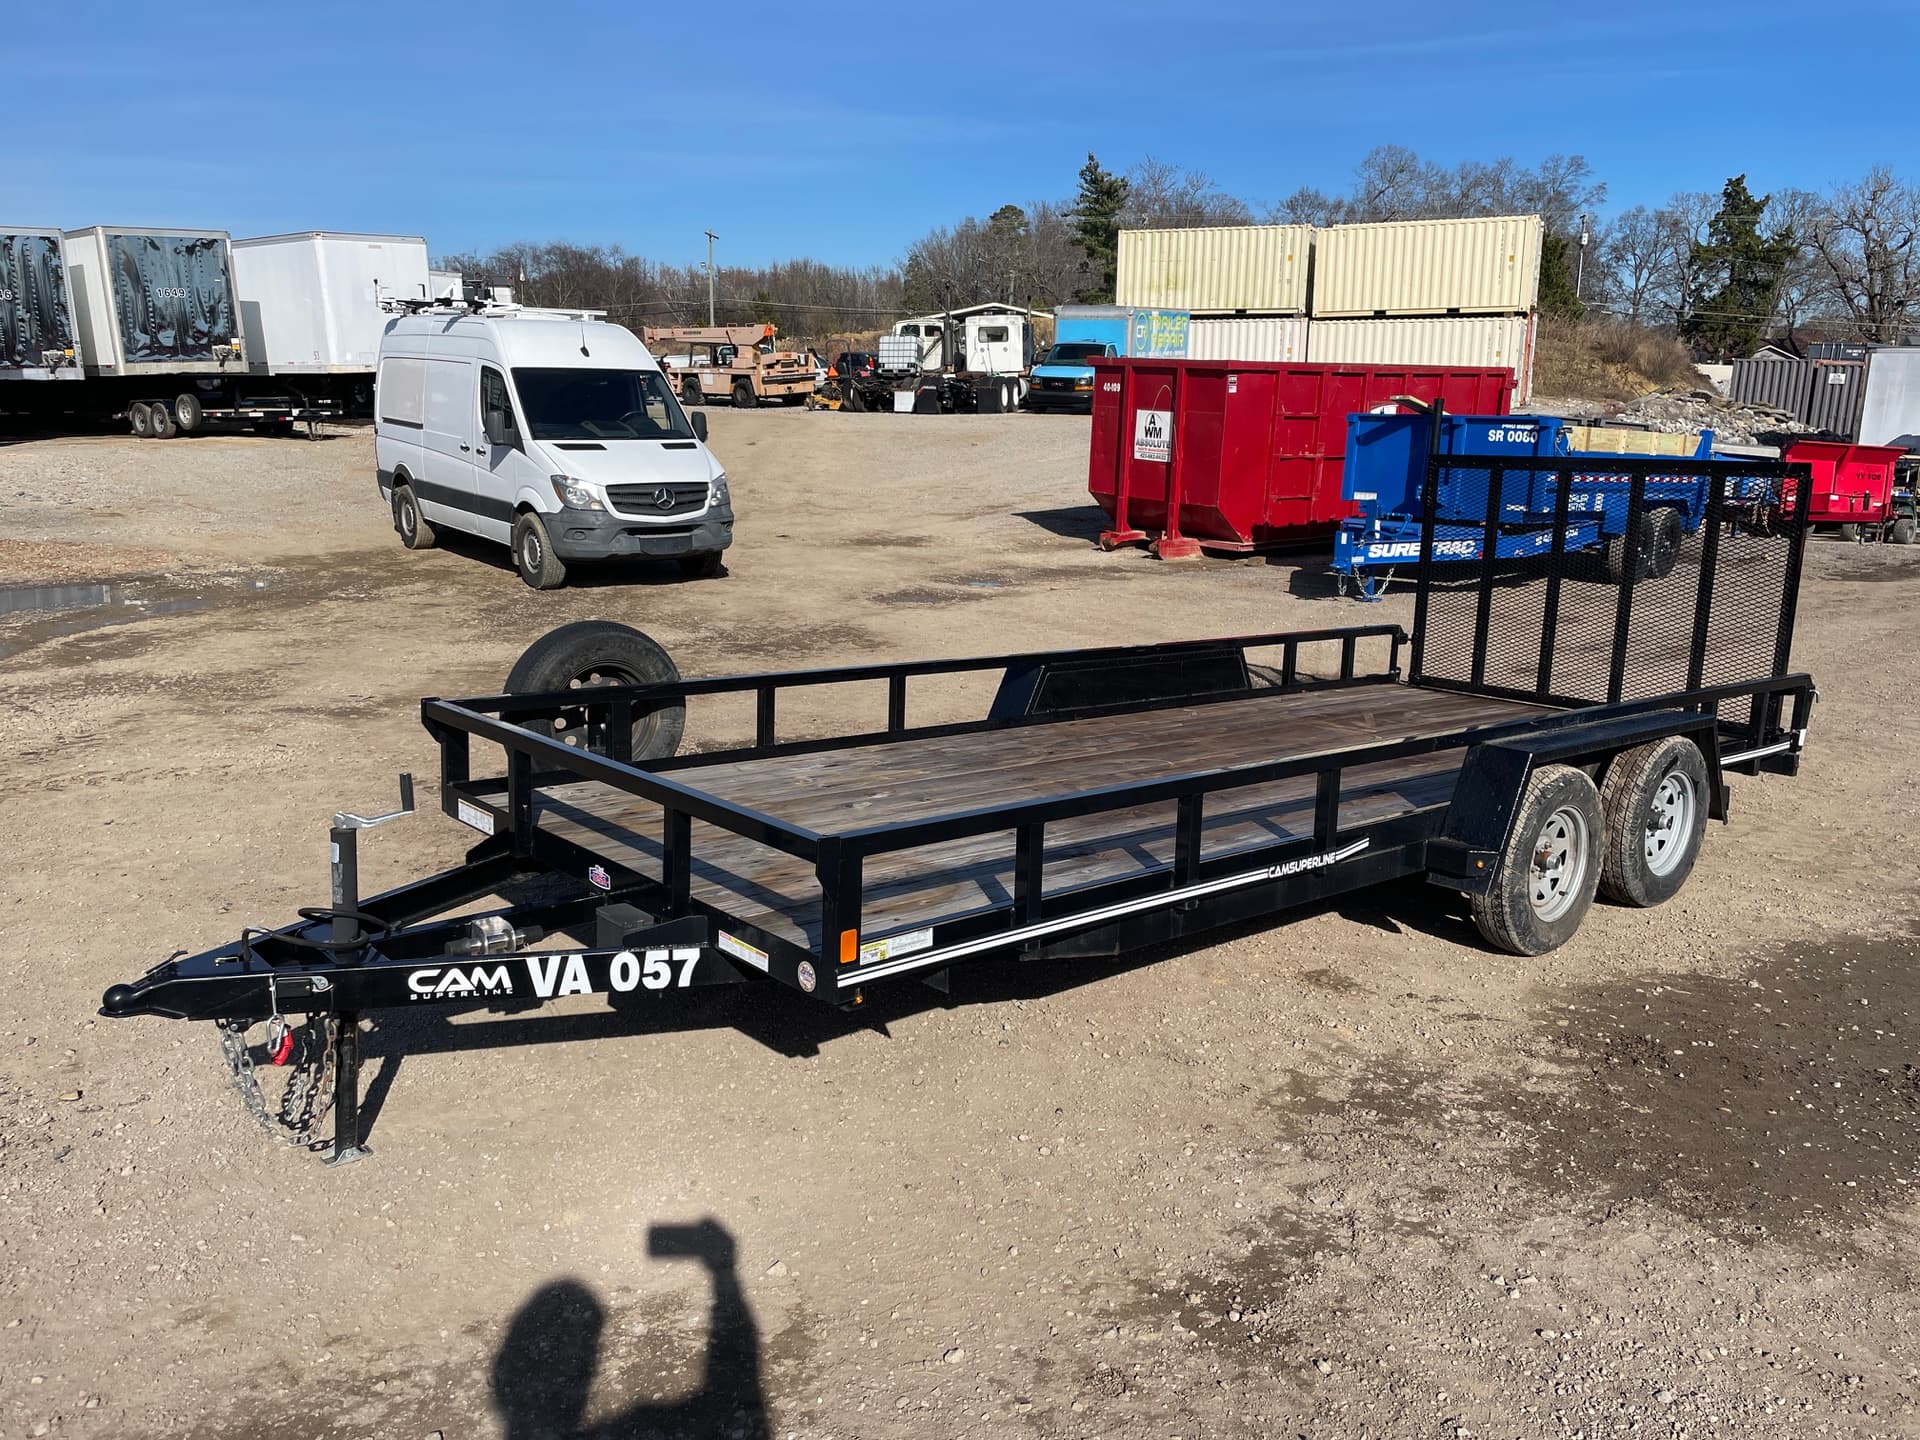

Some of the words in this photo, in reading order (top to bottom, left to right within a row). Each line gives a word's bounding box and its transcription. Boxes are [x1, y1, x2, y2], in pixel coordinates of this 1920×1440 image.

[157, 288, 186, 299] 1649
[1149, 414, 1156, 426] A
[1144, 425, 1162, 439] WM
[1488, 429, 1504, 442] SR
[1507, 430, 1538, 444] 0080
[1136, 438, 1171, 449] ABSOLUTE
[1368, 542, 1421, 559] SURE
[1268, 851, 1336, 879] CAMSUPERLINE
[407, 965, 513, 994] CAM
[526, 954, 594, 998] VA
[609, 947, 701, 992] 057
[410, 987, 514, 1001] SUPERLINE
